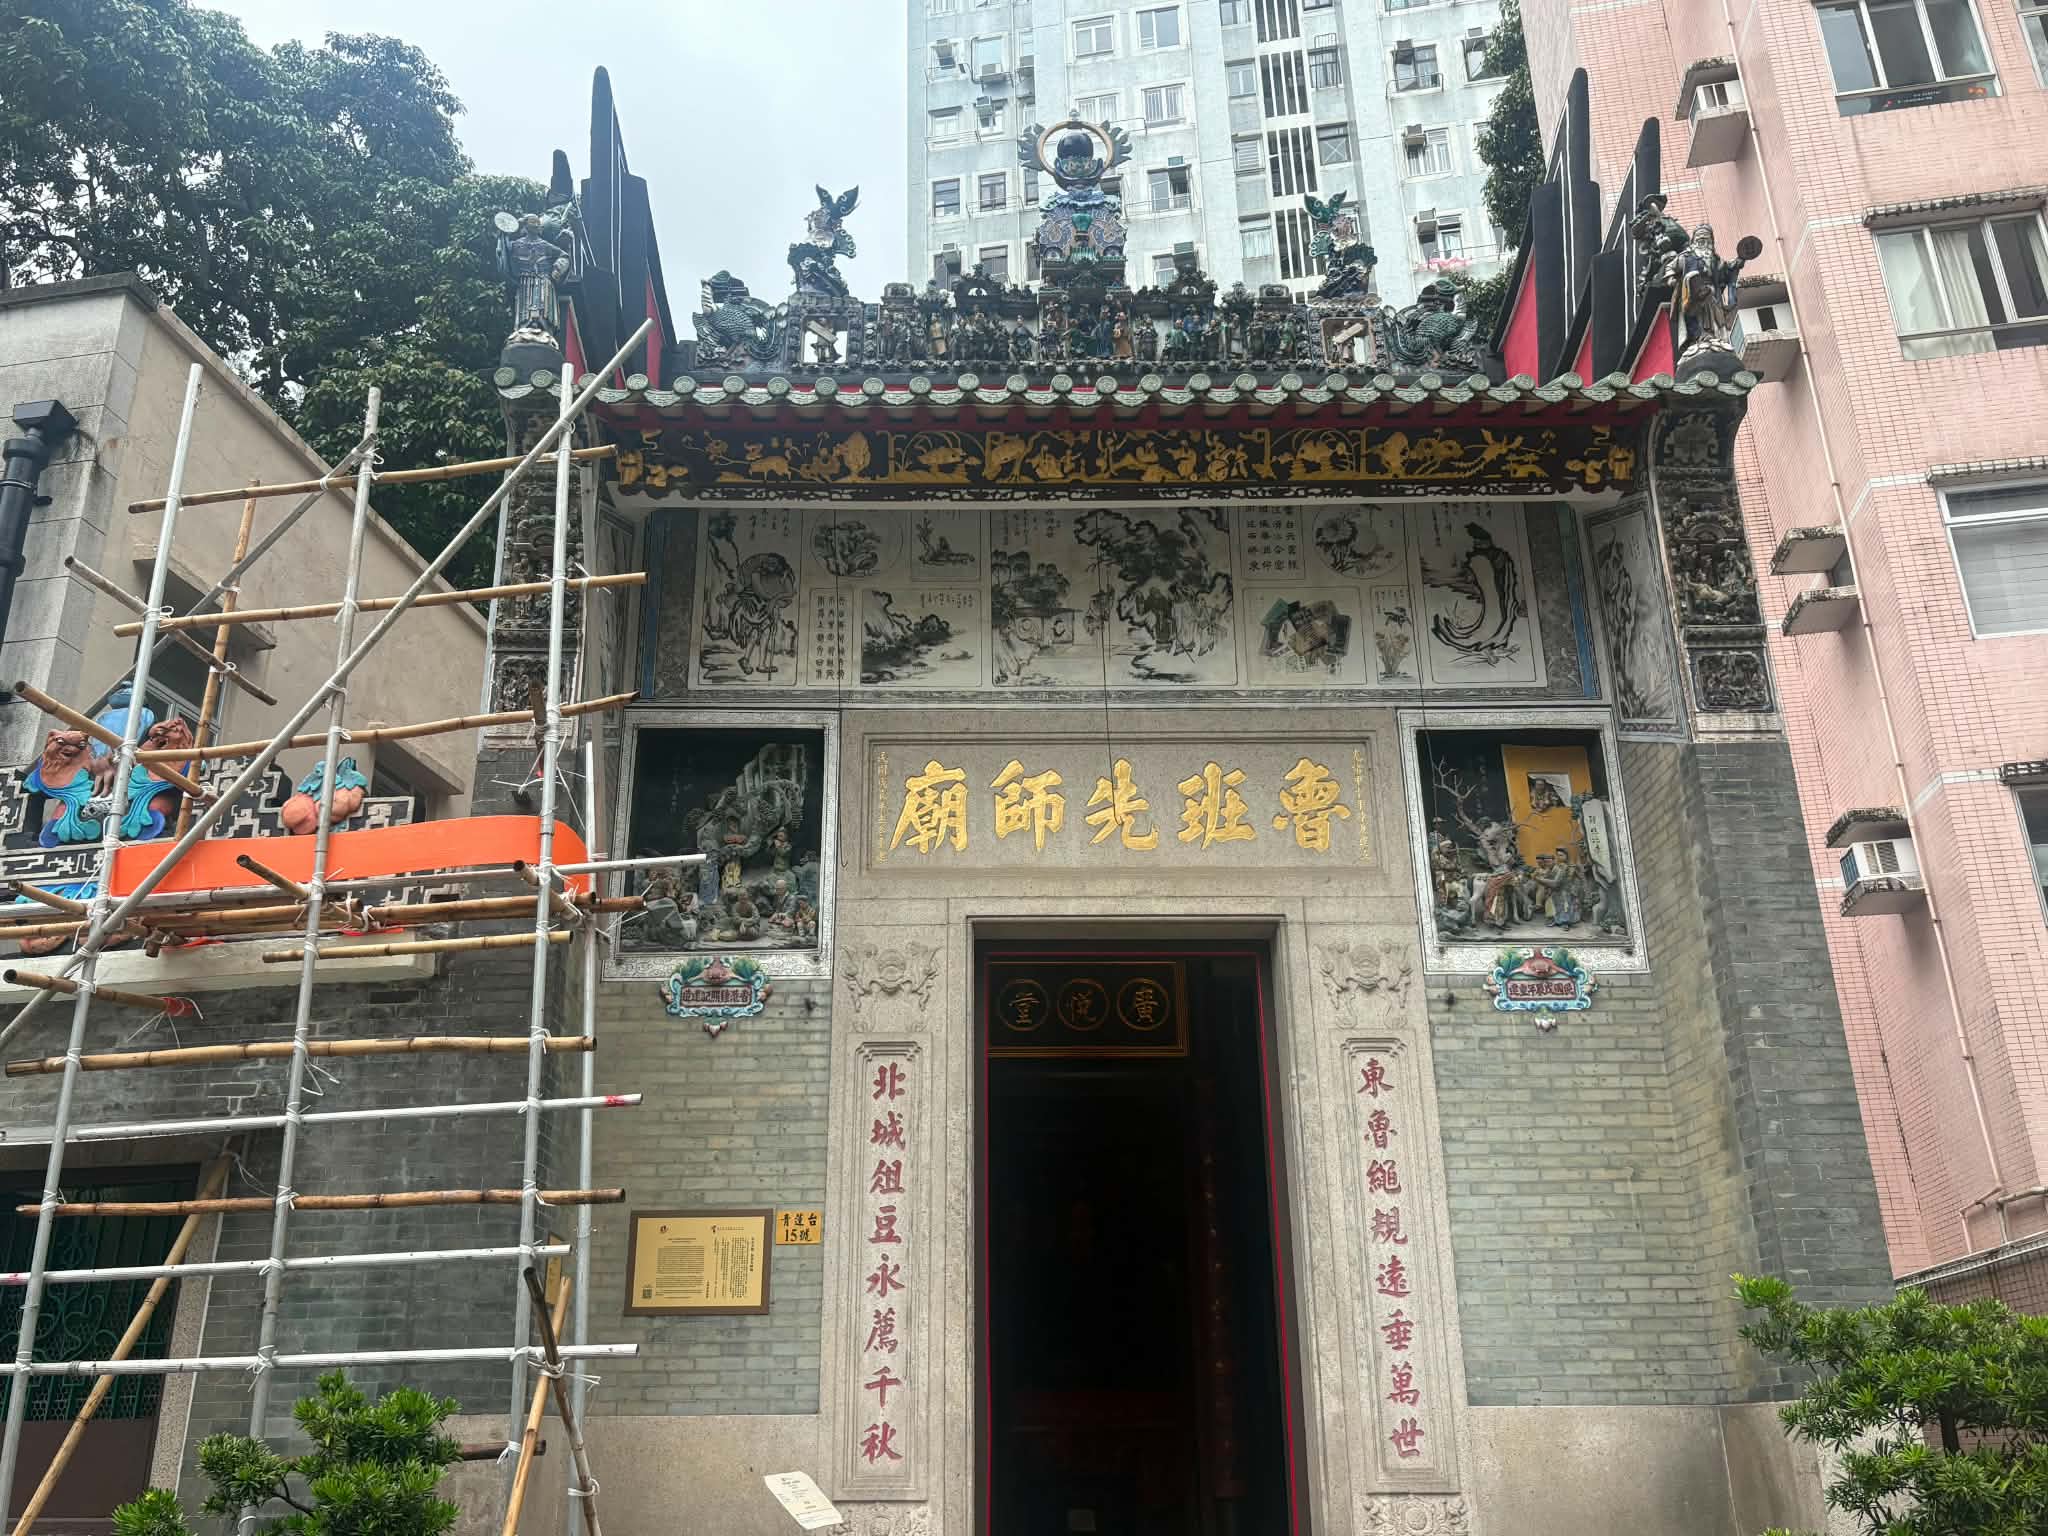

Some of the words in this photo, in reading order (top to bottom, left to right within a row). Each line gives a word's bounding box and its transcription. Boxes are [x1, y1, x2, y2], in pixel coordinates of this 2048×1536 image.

[889, 757, 1351, 854] 魯班先師廟
[784, 1228, 812, 1242] 15號
[860, 1061, 906, 1465] 北城俎豆永薦千秋
[1357, 1057, 1425, 1458] 東魯繩規遠垂萬世
